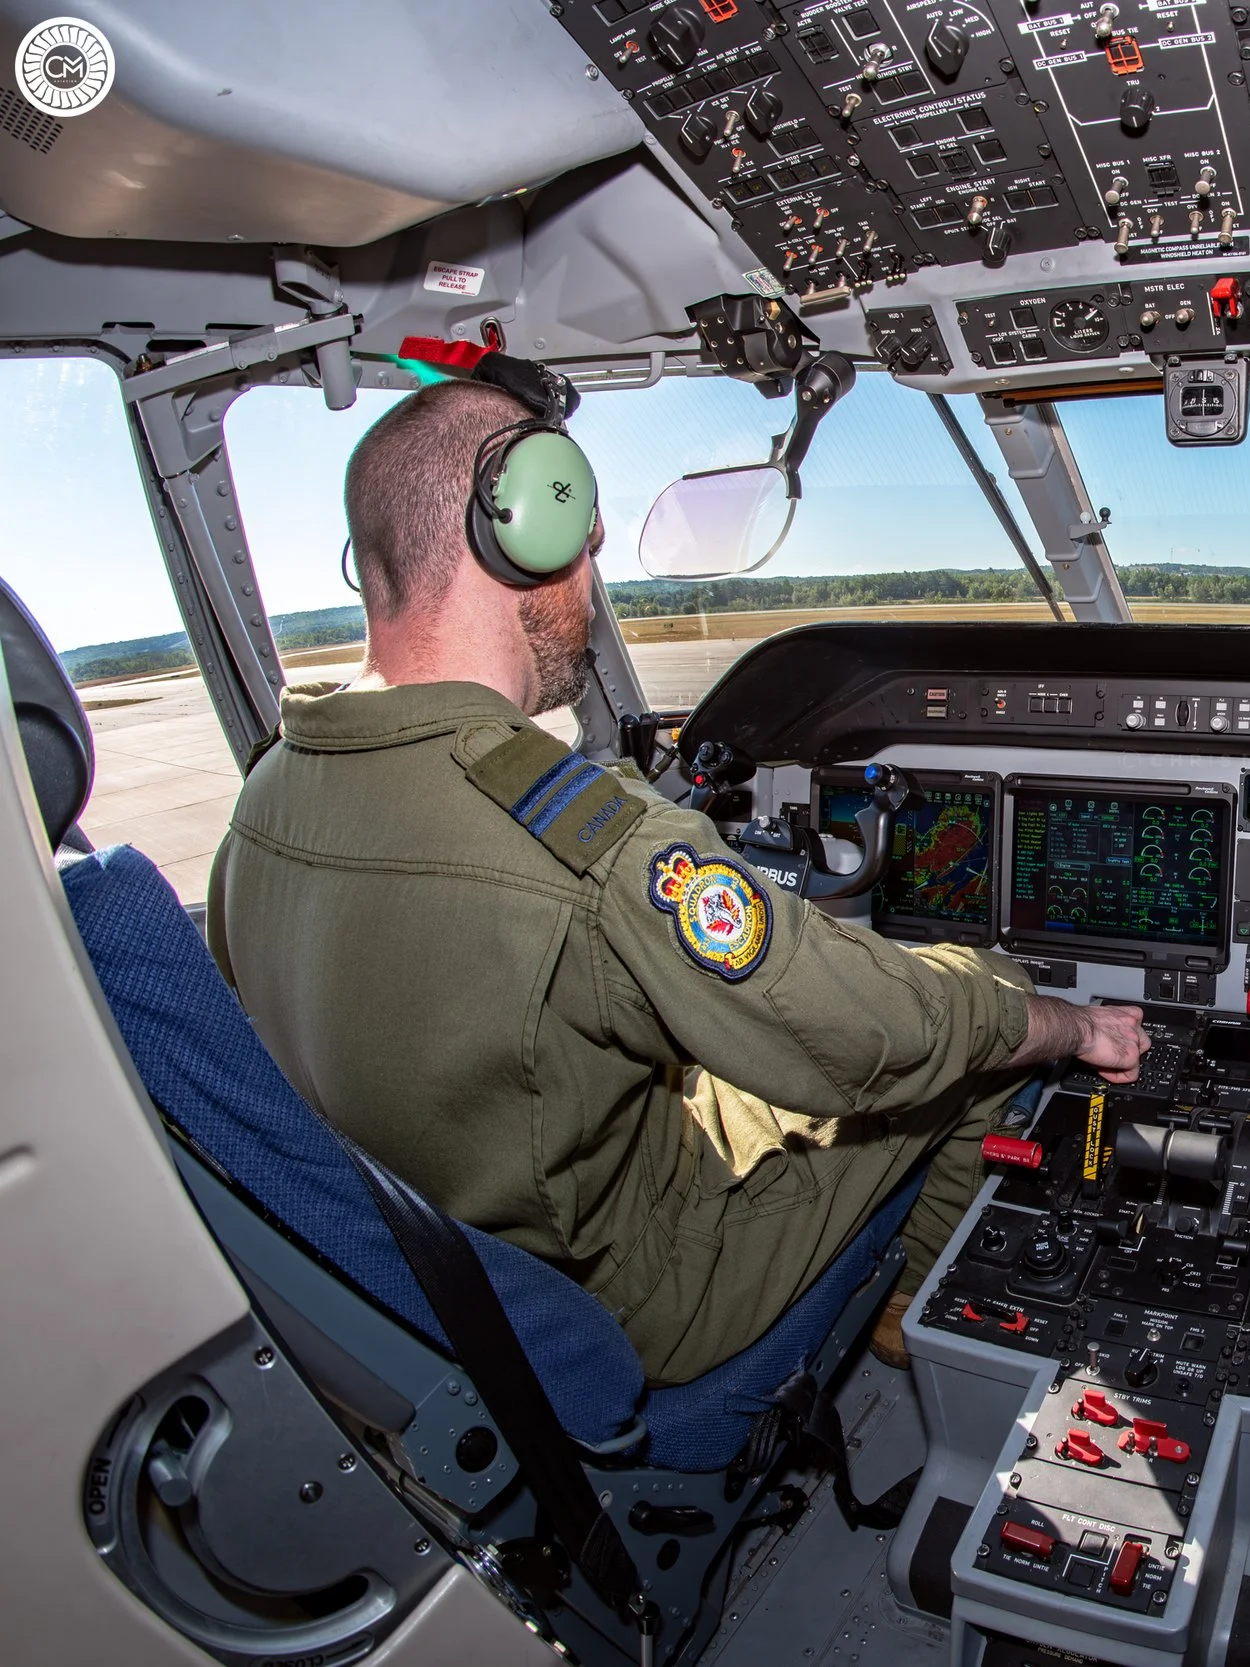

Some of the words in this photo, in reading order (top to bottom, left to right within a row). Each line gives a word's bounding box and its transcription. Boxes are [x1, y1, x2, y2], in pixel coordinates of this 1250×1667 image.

[800, 6, 824, 19] RUDDER
[926, 11, 943, 20] AUTO
[949, 8, 964, 17] LOW
[1084, 11, 1097, 19] OFF
[1156, 10, 1179, 19] RESET
[964, 15, 980, 24] MED
[975, 29, 992, 38] HIGH
[1050, 28, 1071, 37] RESET
[1112, 28, 1125, 37] BUS
[1161, 39, 1172, 47] DC
[1173, 37, 1188, 45] GEN
[1189, 36, 1204, 45] BUS
[1036, 60, 1046, 68] DC
[1047, 58, 1062, 66] GEN
[1063, 55, 1078, 63] BUS
[1126, 79, 1140, 87] TRU
[838, 85, 853, 93] TEST
[873, 108, 917, 125] ELECTRONIC
[918, 91, 986, 113] CONTROL/STATUS
[915, 108, 948, 120] PROPELLER
[935, 136, 957, 146] ENGINE
[946, 182, 972, 192] ENGINE
[973, 178, 996, 187] START
[776, 195, 803, 207] EXTERNAL
[805, 191, 815, 201] LT
[1140, 246, 1165, 255] MAGNETIC
[1165, 244, 1188, 253] COMPASS
[1189, 242, 1221, 252] UNRELIABLE
[434, 266, 458, 276] ESCAPE
[458, 270, 478, 278] STRAP
[442, 275, 457, 283] PULL
[438, 282, 466, 290] RELEASE
[1144, 284, 1164, 293] MSTR
[1167, 283, 1185, 291] ELEC
[1020, 297, 1046, 306] OXYGEN
[577, 795, 628, 843] CANADA
[690, 875, 717, 922] SQUADRON
[1092, 1107, 1100, 1133] GUST
[1009, 1304, 1024, 1312] EXTN
[1144, 1309, 1178, 1320] MARKPOINT
[1173, 1369, 1192, 1377] UNSAFE
[1114, 1392, 1130, 1402] STBY
[1132, 1396, 1151, 1405] TRIMS
[88, 1457, 112, 1517] OPEN
[1031, 1519, 1044, 1528] ROLL
[1062, 1513, 1075, 1523] FLT
[1077, 1516, 1096, 1529] CONT
[1098, 1521, 1116, 1533] DISC
[1003, 1553, 1011, 1561] TIE
[1013, 1556, 1031, 1567] NORM
[1033, 1561, 1050, 1573] UNTIE
[1148, 1563, 1166, 1571] UNTIE
[1095, 1566, 1109, 1594] PITCH
[1145, 1572, 1162, 1581] NORM
